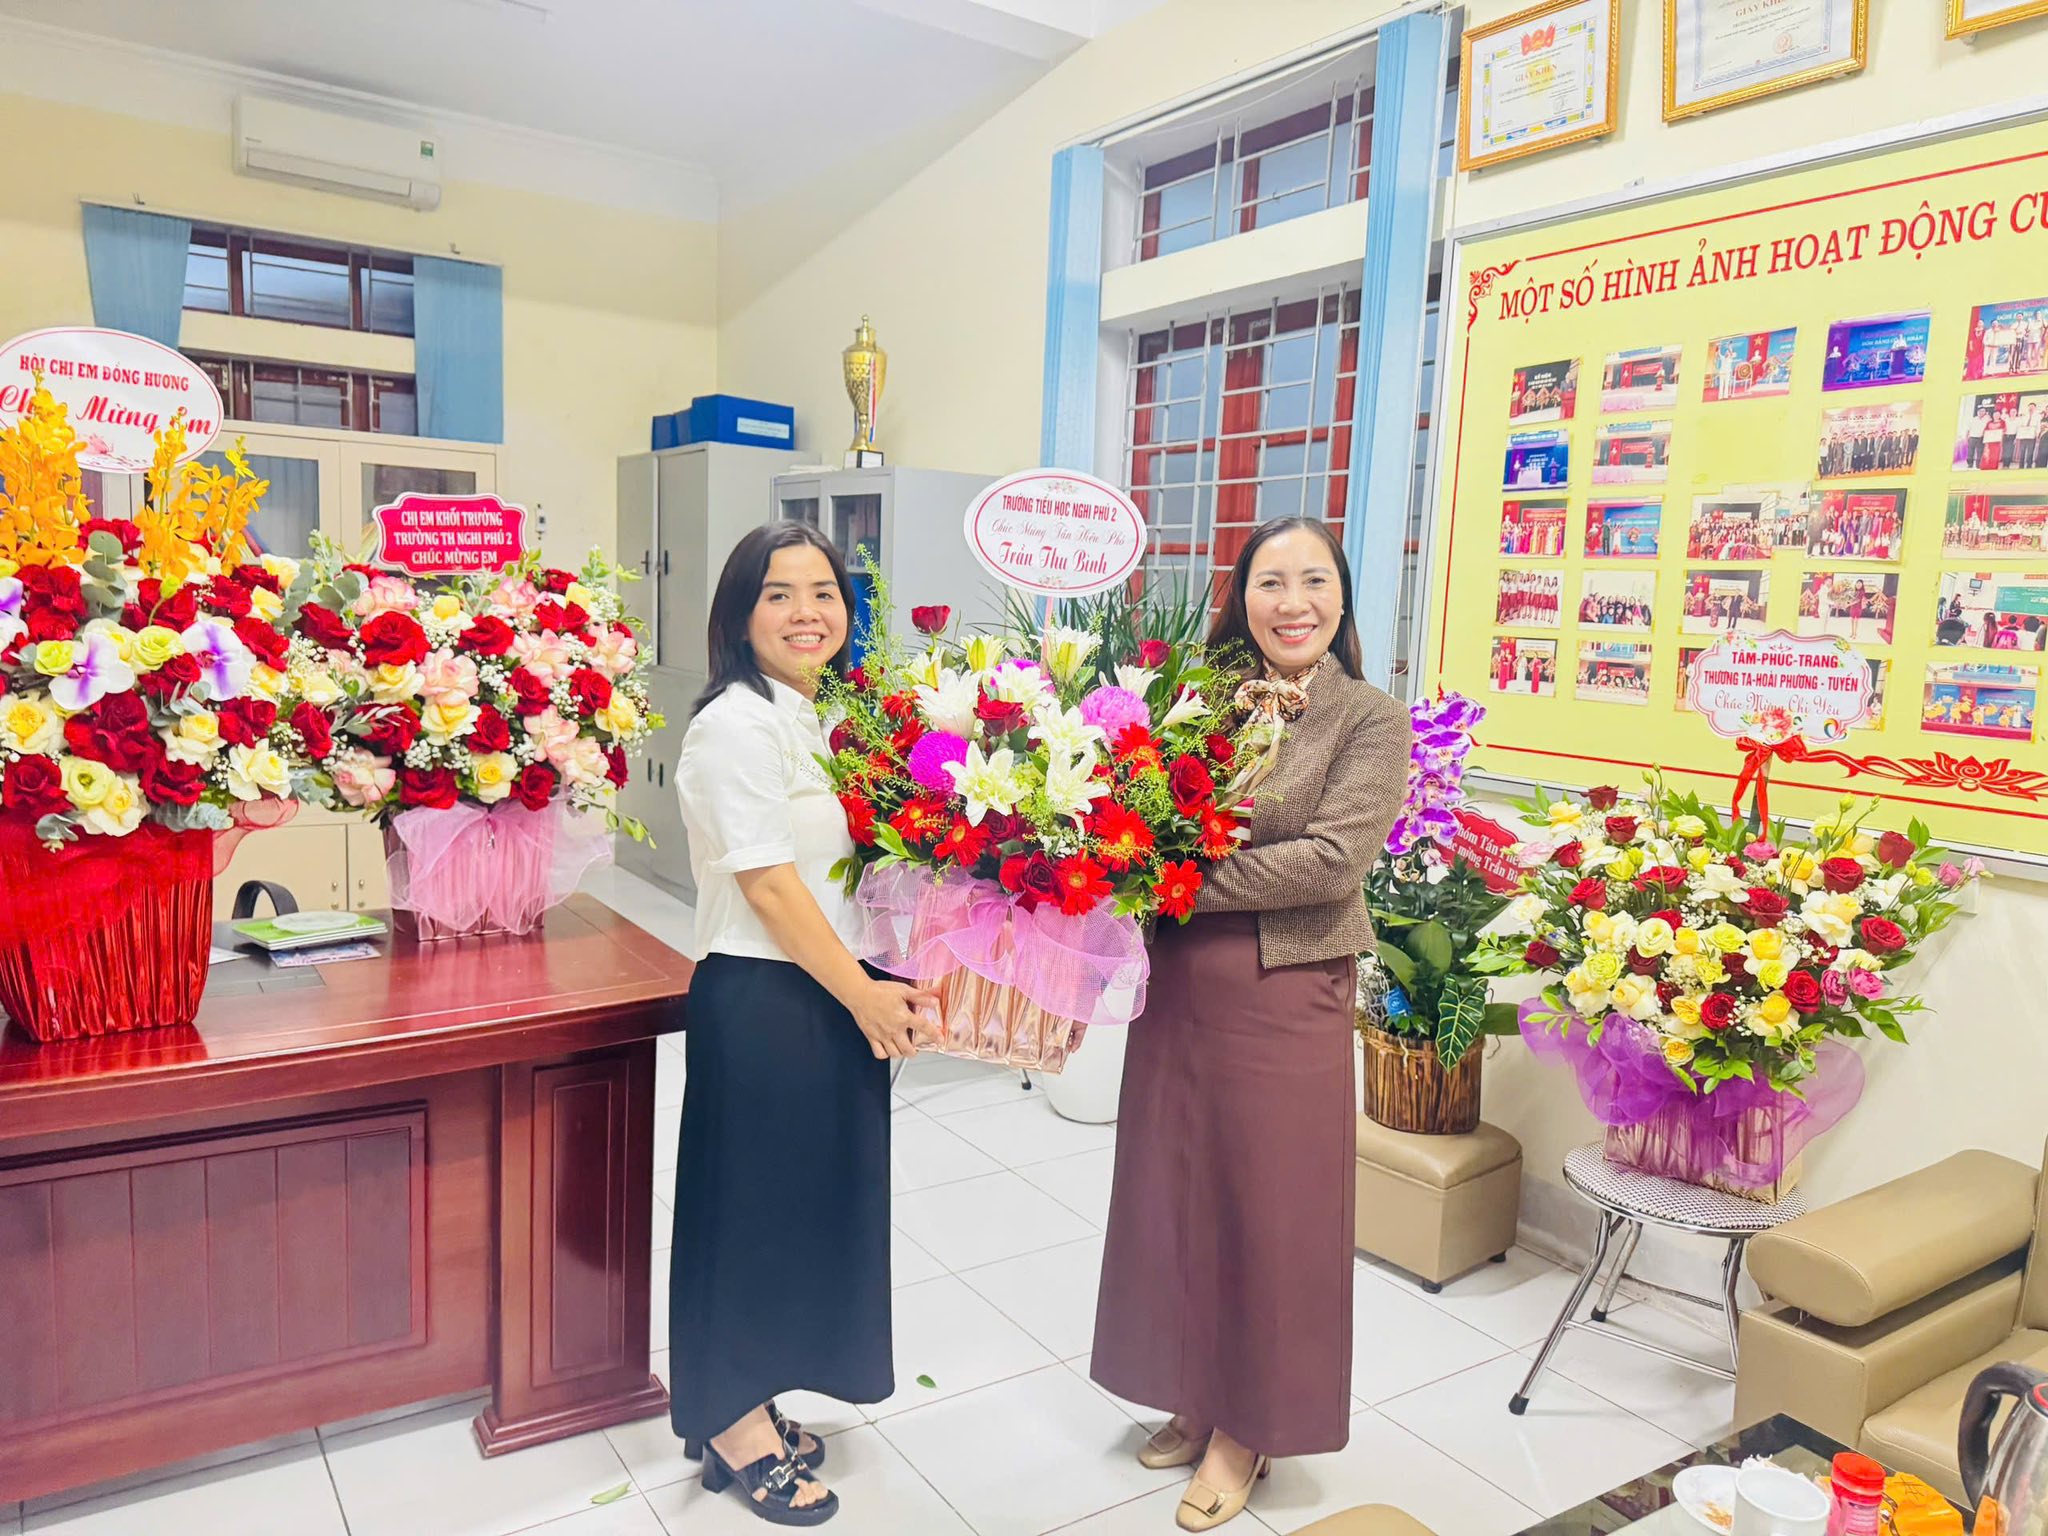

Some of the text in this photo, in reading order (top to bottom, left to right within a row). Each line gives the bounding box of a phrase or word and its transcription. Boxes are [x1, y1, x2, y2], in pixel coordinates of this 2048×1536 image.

[1498, 277, 1554, 324] MỘT
[1559, 259, 1598, 309] SỐ
[1601, 258, 1680, 302] HÌNH
[1686, 238, 1760, 287] ẢNH
[1767, 224, 1870, 274] HOẠT
[1878, 200, 1998, 260] ĐỘNG
[50, 359, 74, 380] CHỊ
[78, 363, 98, 379] EM
[76, 395, 160, 434] Mừng
[401, 511, 418, 529] CHỊ
[420, 511, 434, 526] EM
[435, 507, 460, 526] KHỐI
[1003, 493, 1033, 513] TRƯỜNG
[1054, 500, 1070, 520] HỌC
[1072, 502, 1091, 519] NGHI
[1111, 507, 1118, 522] 2
[393, 529, 439, 546] TRƯỜNG
[440, 531, 455, 546] TH
[456, 531, 482, 546] NGHI
[505, 531, 513, 546] 2
[411, 548, 498, 564] CHÚC MỪNG EM
[1040, 545, 1067, 570] Thu
[1457, 823, 1478, 846] hóm
